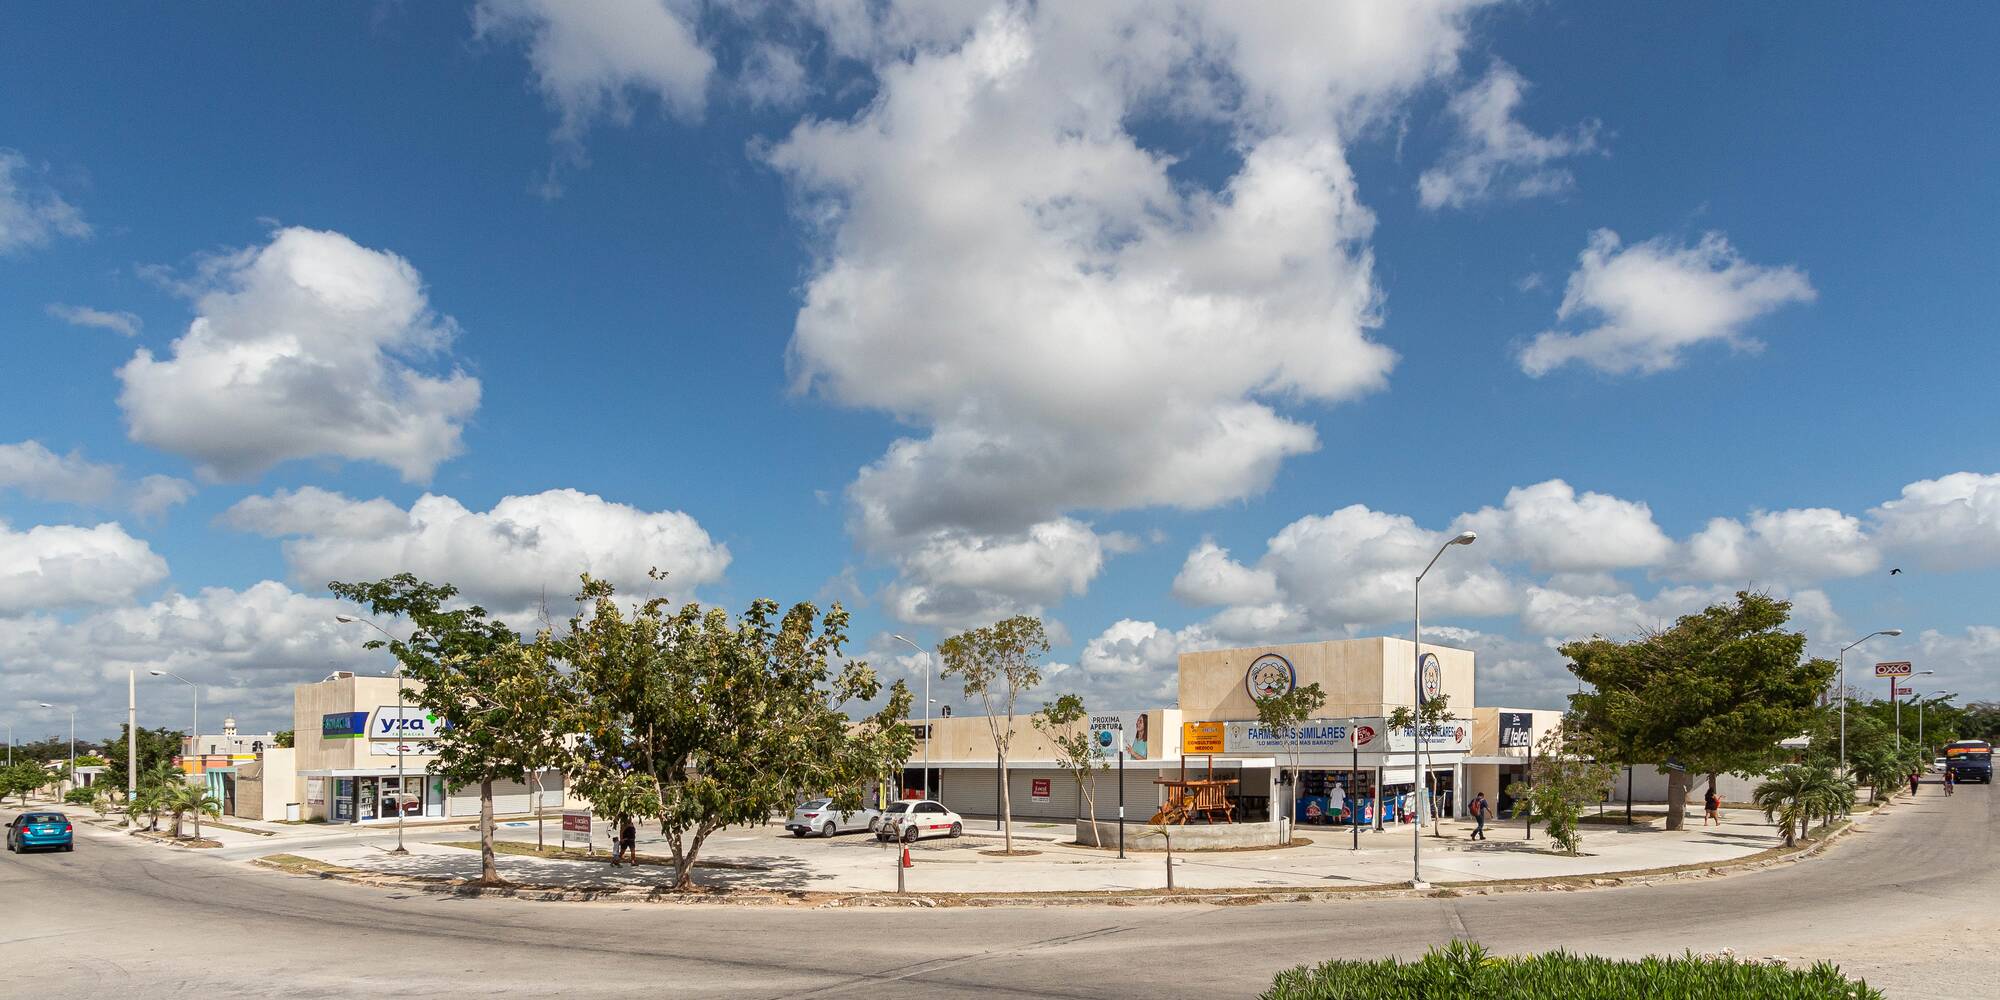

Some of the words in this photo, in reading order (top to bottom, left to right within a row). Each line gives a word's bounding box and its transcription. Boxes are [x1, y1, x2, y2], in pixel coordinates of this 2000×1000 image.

[1877, 665, 1910, 674] OXXO
[380, 718, 424, 733] yza
[1298, 726, 1346, 739] SIMILARES
[1510, 727, 1531, 746] telce
